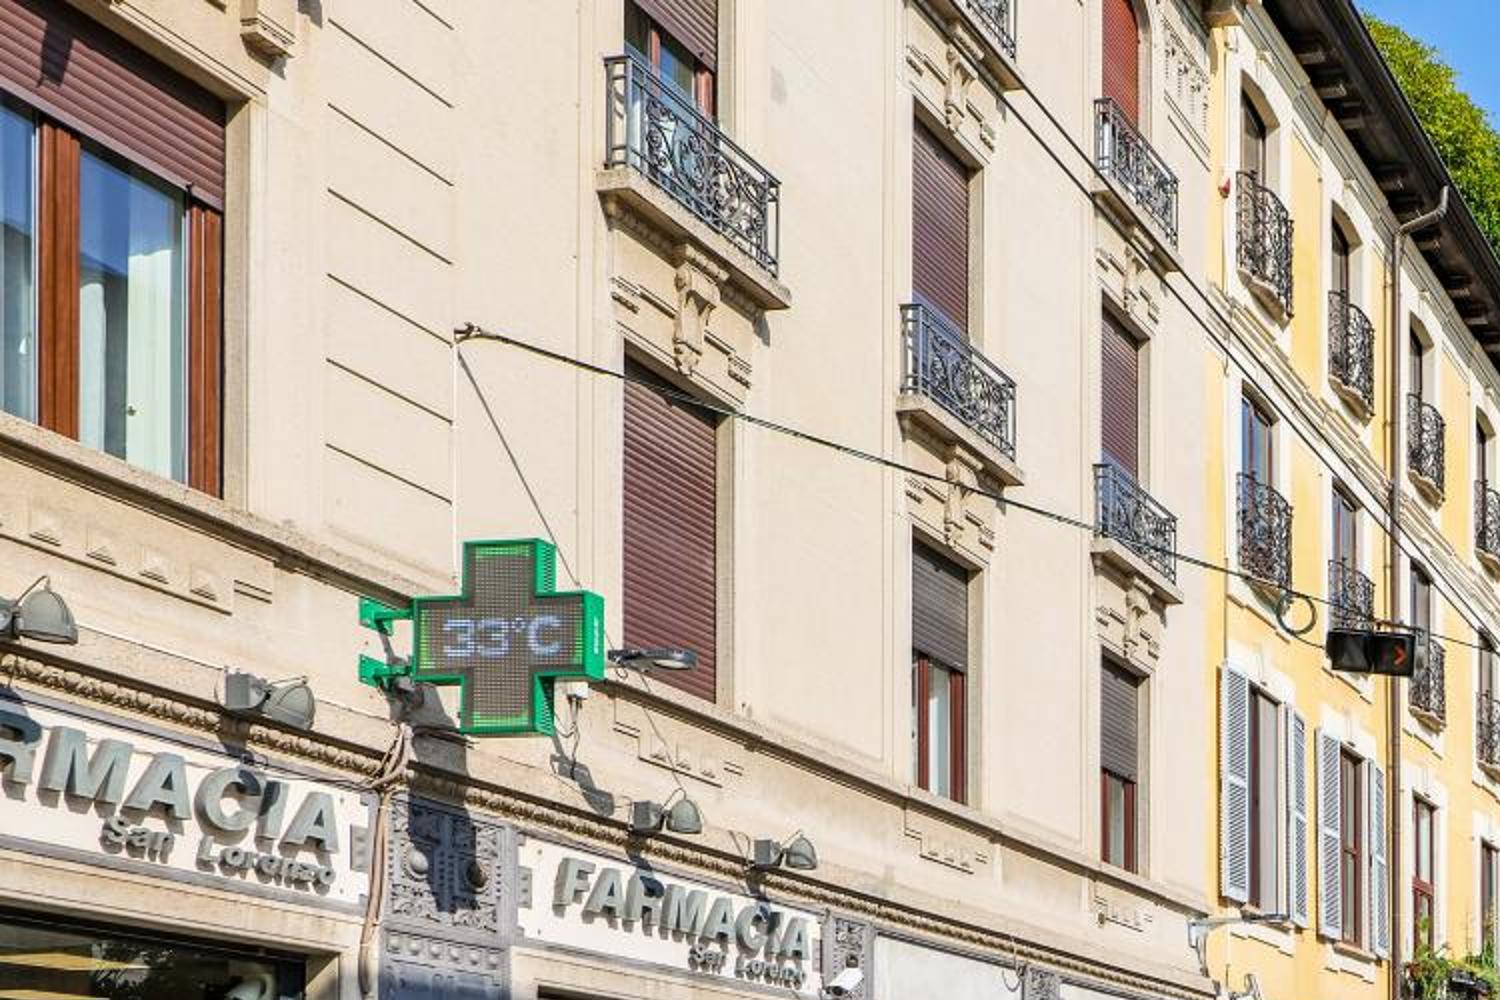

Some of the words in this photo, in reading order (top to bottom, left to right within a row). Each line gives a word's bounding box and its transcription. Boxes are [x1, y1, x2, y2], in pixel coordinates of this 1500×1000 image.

[104, 815, 175, 858] San
[199, 835, 338, 889] Lorenzo
[552, 856, 810, 962] FARMACIA
